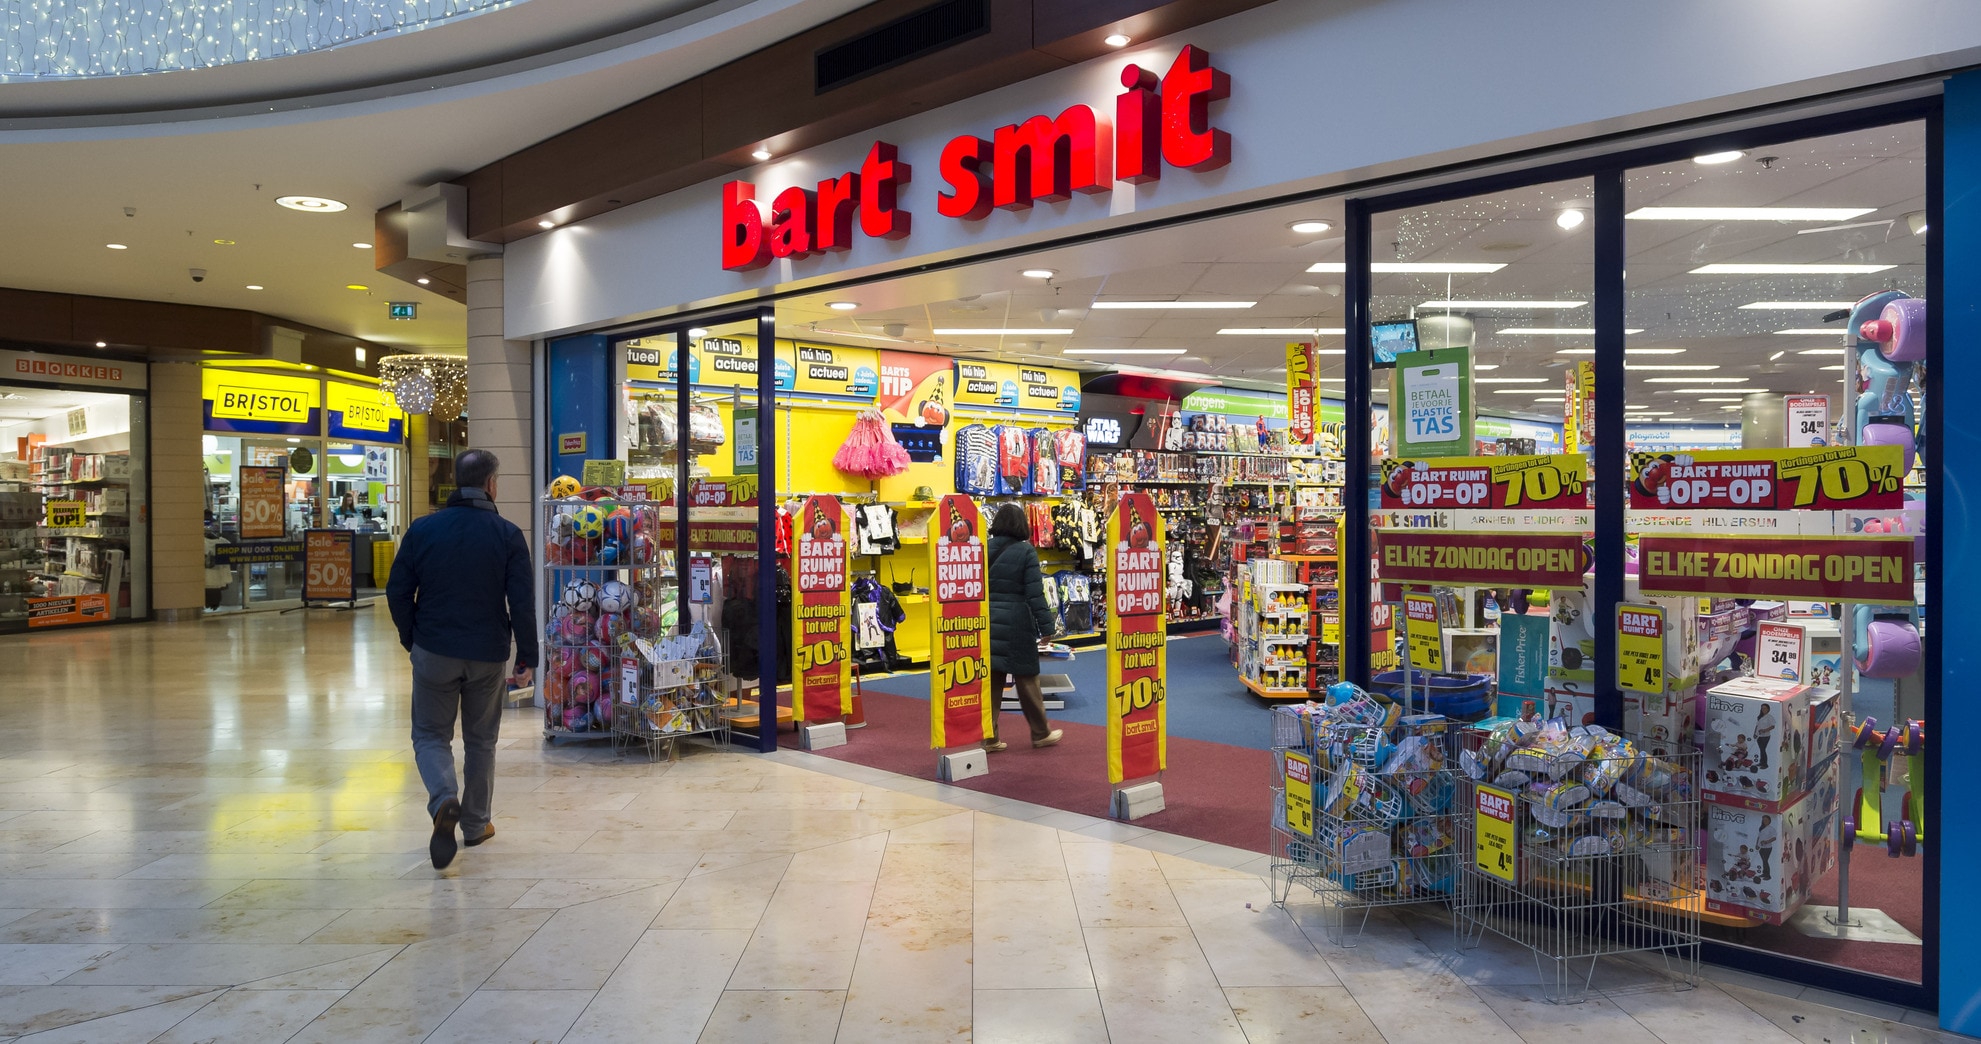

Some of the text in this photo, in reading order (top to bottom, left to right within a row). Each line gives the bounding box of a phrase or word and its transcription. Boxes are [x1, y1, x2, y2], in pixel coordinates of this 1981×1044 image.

[722, 44, 1231, 272] bart smit
[705, 338, 740, 354] nú hip
[627, 349, 658, 364] tueel
[801, 349, 832, 363] nú hip
[18, 360, 120, 379] BLOKKER
[715, 358, 758, 372] actueel
[881, 366, 909, 377] BARTS
[810, 367, 847, 379] actueel
[973, 367, 986, 379] hip
[1035, 371, 1046, 383] hip
[881, 377, 912, 396] TIP
[968, 382, 997, 393] actueel
[1029, 387, 1058, 398] actueel
[1186, 391, 1226, 411] jongens
[1411, 389, 1452, 401] BETAAL
[1300, 389, 1311, 429] OP=OP
[1412, 398, 1452, 409] JE VOOR JE
[1412, 407, 1452, 417] PLASTIC
[1088, 419, 1119, 432] STAR
[1412, 416, 1454, 435] TAS
[1087, 430, 1120, 443] WARS
[1629, 431, 1671, 441] playmobil
[738, 451, 754, 461] TAS
[1781, 448, 1855, 469] Kortingen tot wel
[1494, 456, 1551, 474] Kortingen tot wel
[1670, 464, 1771, 478] BART RUIMT
[242, 473, 264, 484] Sale
[1411, 470, 1487, 482] BART RUIMT
[1782, 457, 1898, 507] 70%
[1411, 483, 1488, 505] OP=OP
[1495, 466, 1583, 507] 70%
[1670, 479, 1771, 505] OP=OP
[243, 500, 282, 523] 50%
[53, 515, 80, 525] OP!
[1370, 511, 1448, 528] art smit
[1470, 515, 1516, 525] ARNHEM
[1702, 517, 1777, 528] HILVERSUM
[1845, 512, 1912, 534] bart
[308, 536, 332, 547] Sale
[737, 530, 756, 543] OPEN
[217, 547, 239, 555] SHOP
[254, 546, 271, 554] OOK
[801, 542, 843, 556] BART
[938, 545, 982, 563] BART
[801, 558, 843, 573] RUIMT
[1117, 552, 1160, 570] BART
[1385, 545, 1575, 572] ELKE ZONDAG OPEN
[308, 563, 351, 586] 50%
[938, 564, 982, 581] RUIMT
[1647, 551, 1903, 584] ELKE ZONDAG OPEN
[801, 574, 843, 590] OP=OP
[1117, 572, 1160, 591] RUIMT
[939, 583, 982, 600] OP=OP
[1118, 593, 1160, 613] OP=OP
[1267, 604, 1276, 612] ME
[1407, 600, 1433, 613] BART
[36, 607, 69, 616] ARTIKELEN
[797, 604, 845, 619] Kortingen
[806, 619, 838, 633] tot wel
[937, 616, 986, 633] Kortingen
[1622, 613, 1658, 628] BART
[1623, 625, 1658, 636] RUIMT OP!
[1762, 630, 1800, 639] BODEMPRIJS
[946, 632, 978, 649] tot wel
[1115, 630, 1164, 651] Kortingen
[797, 640, 847, 672] 70%
[1124, 650, 1156, 669] tot wel
[1265, 657, 1274, 665] ME
[807, 674, 838, 685] bart smit
[938, 656, 988, 692] 70%
[949, 694, 978, 707] bart smit
[1115, 676, 1164, 718] 70%
[1127, 720, 1156, 735] bart smit
[1287, 758, 1308, 775] BART
[1480, 792, 1510, 813] BART
